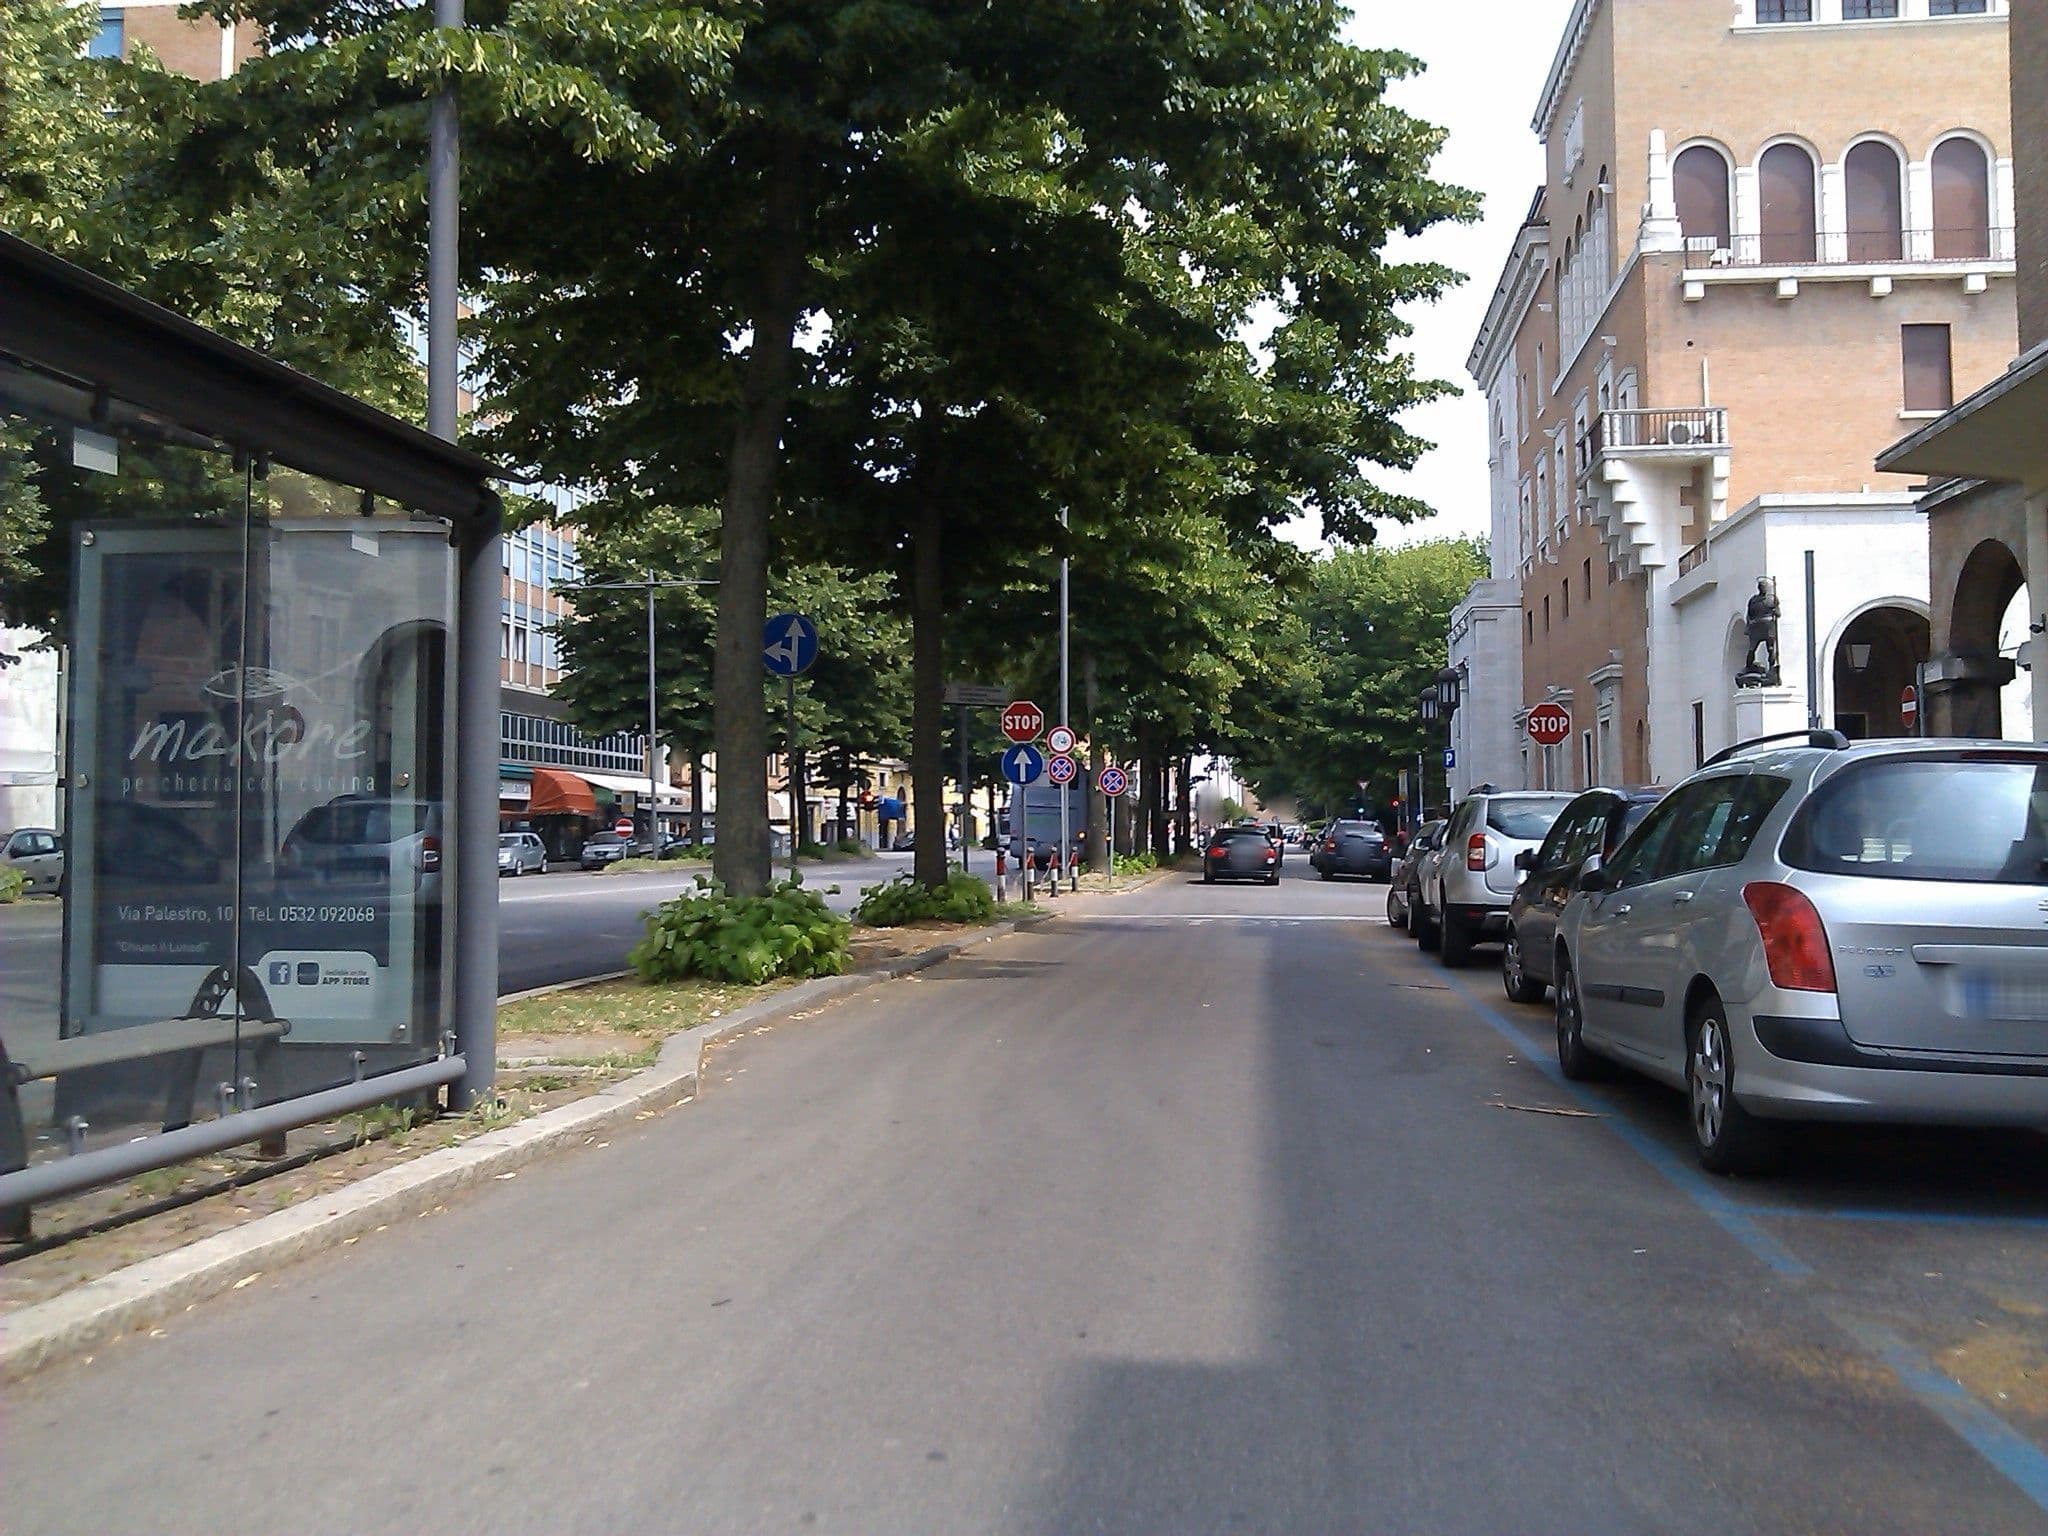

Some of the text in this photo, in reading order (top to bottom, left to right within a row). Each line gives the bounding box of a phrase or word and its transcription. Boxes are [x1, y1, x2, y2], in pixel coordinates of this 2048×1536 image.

[1004, 714, 1041, 731] STOP
[1529, 716, 1568, 733] STOP
[1445, 752, 1454, 766] P
[119, 905, 233, 924] Via Palestro, 10
[280, 906, 316, 922] 0532
[320, 906, 375, 922] 092068
[322, 977, 369, 985] APP STORE
